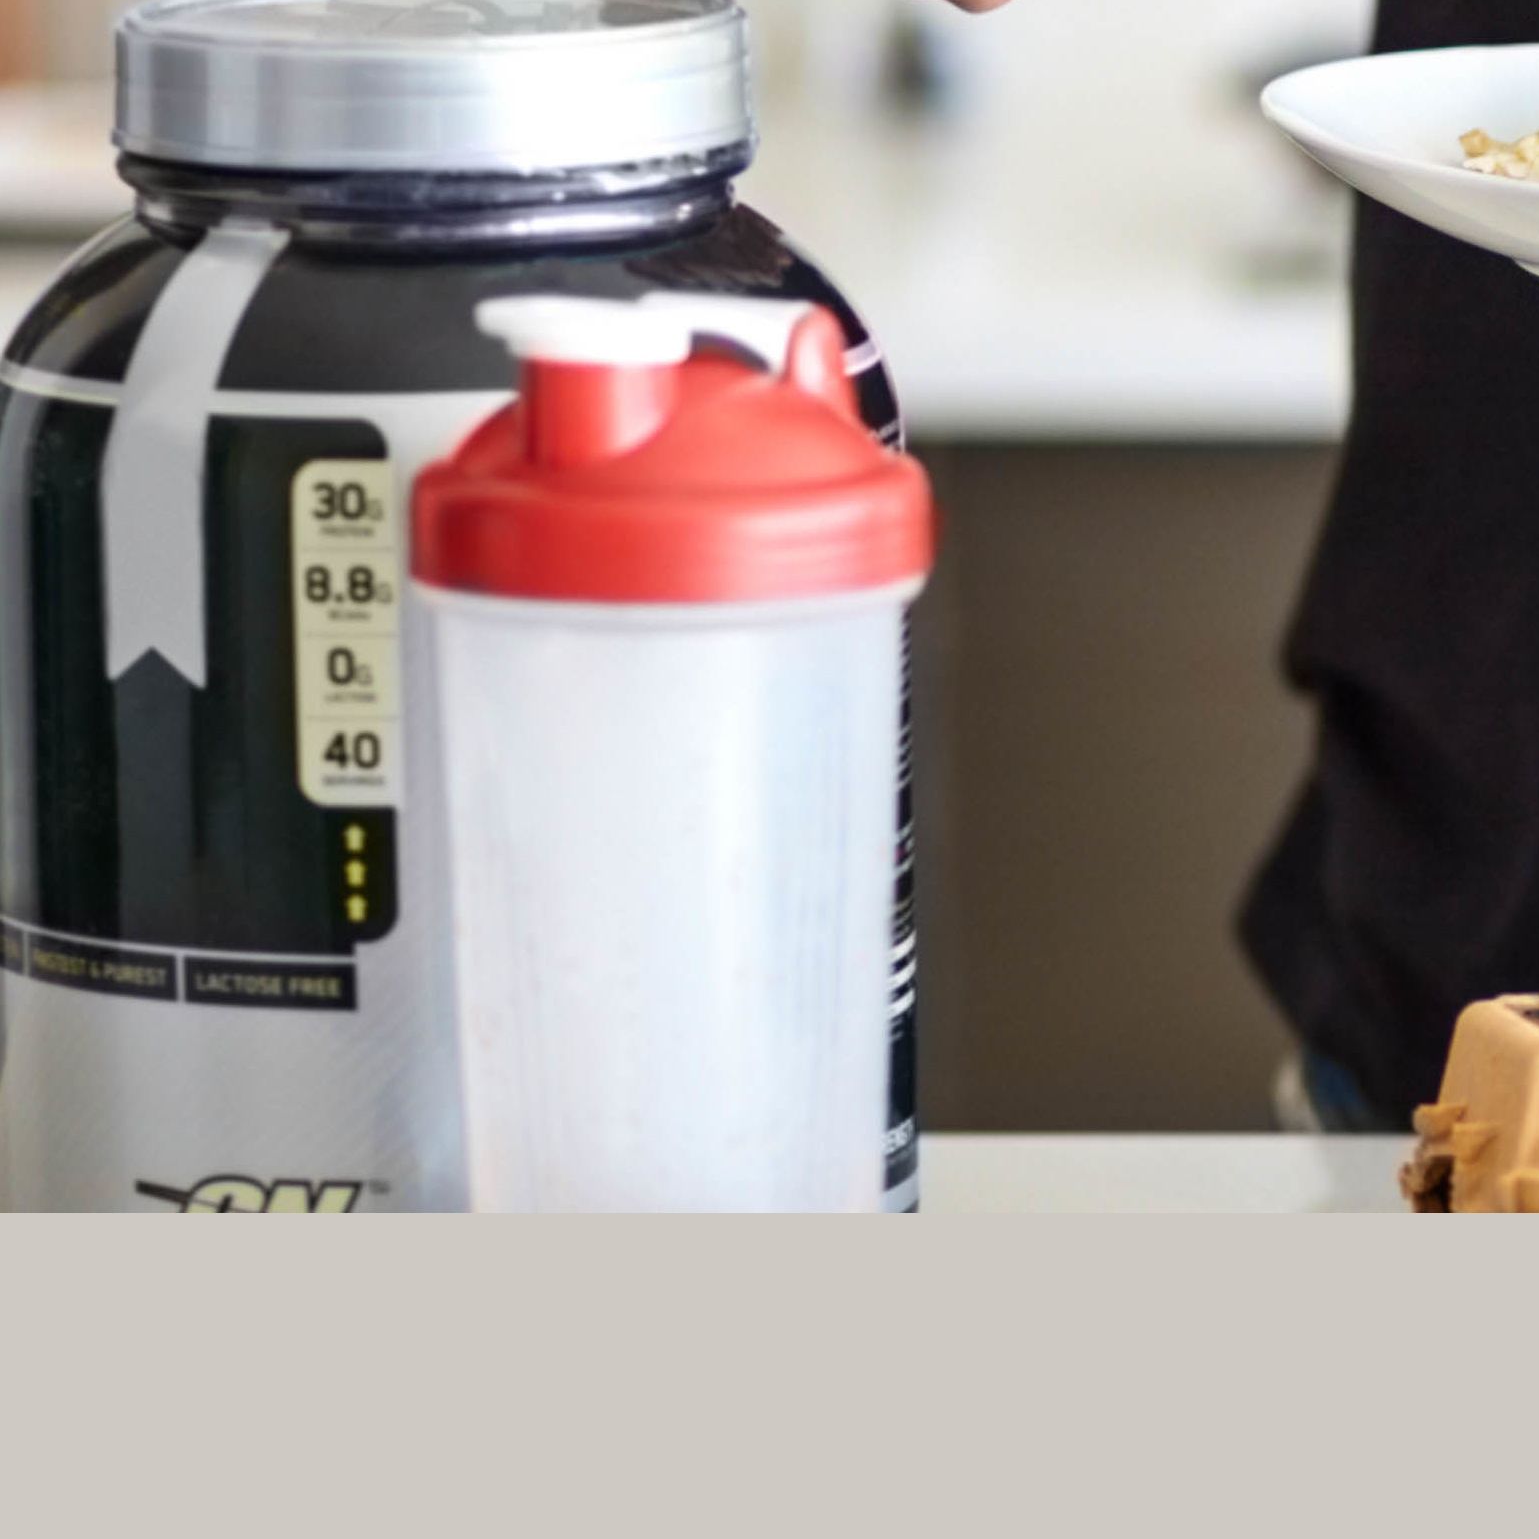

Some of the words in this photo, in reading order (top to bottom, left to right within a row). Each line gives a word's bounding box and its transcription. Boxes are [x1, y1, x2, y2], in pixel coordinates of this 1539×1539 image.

[323, 731, 381, 770] 40
[194, 971, 283, 996] LACTOSE
[288, 974, 343, 999] FREE
